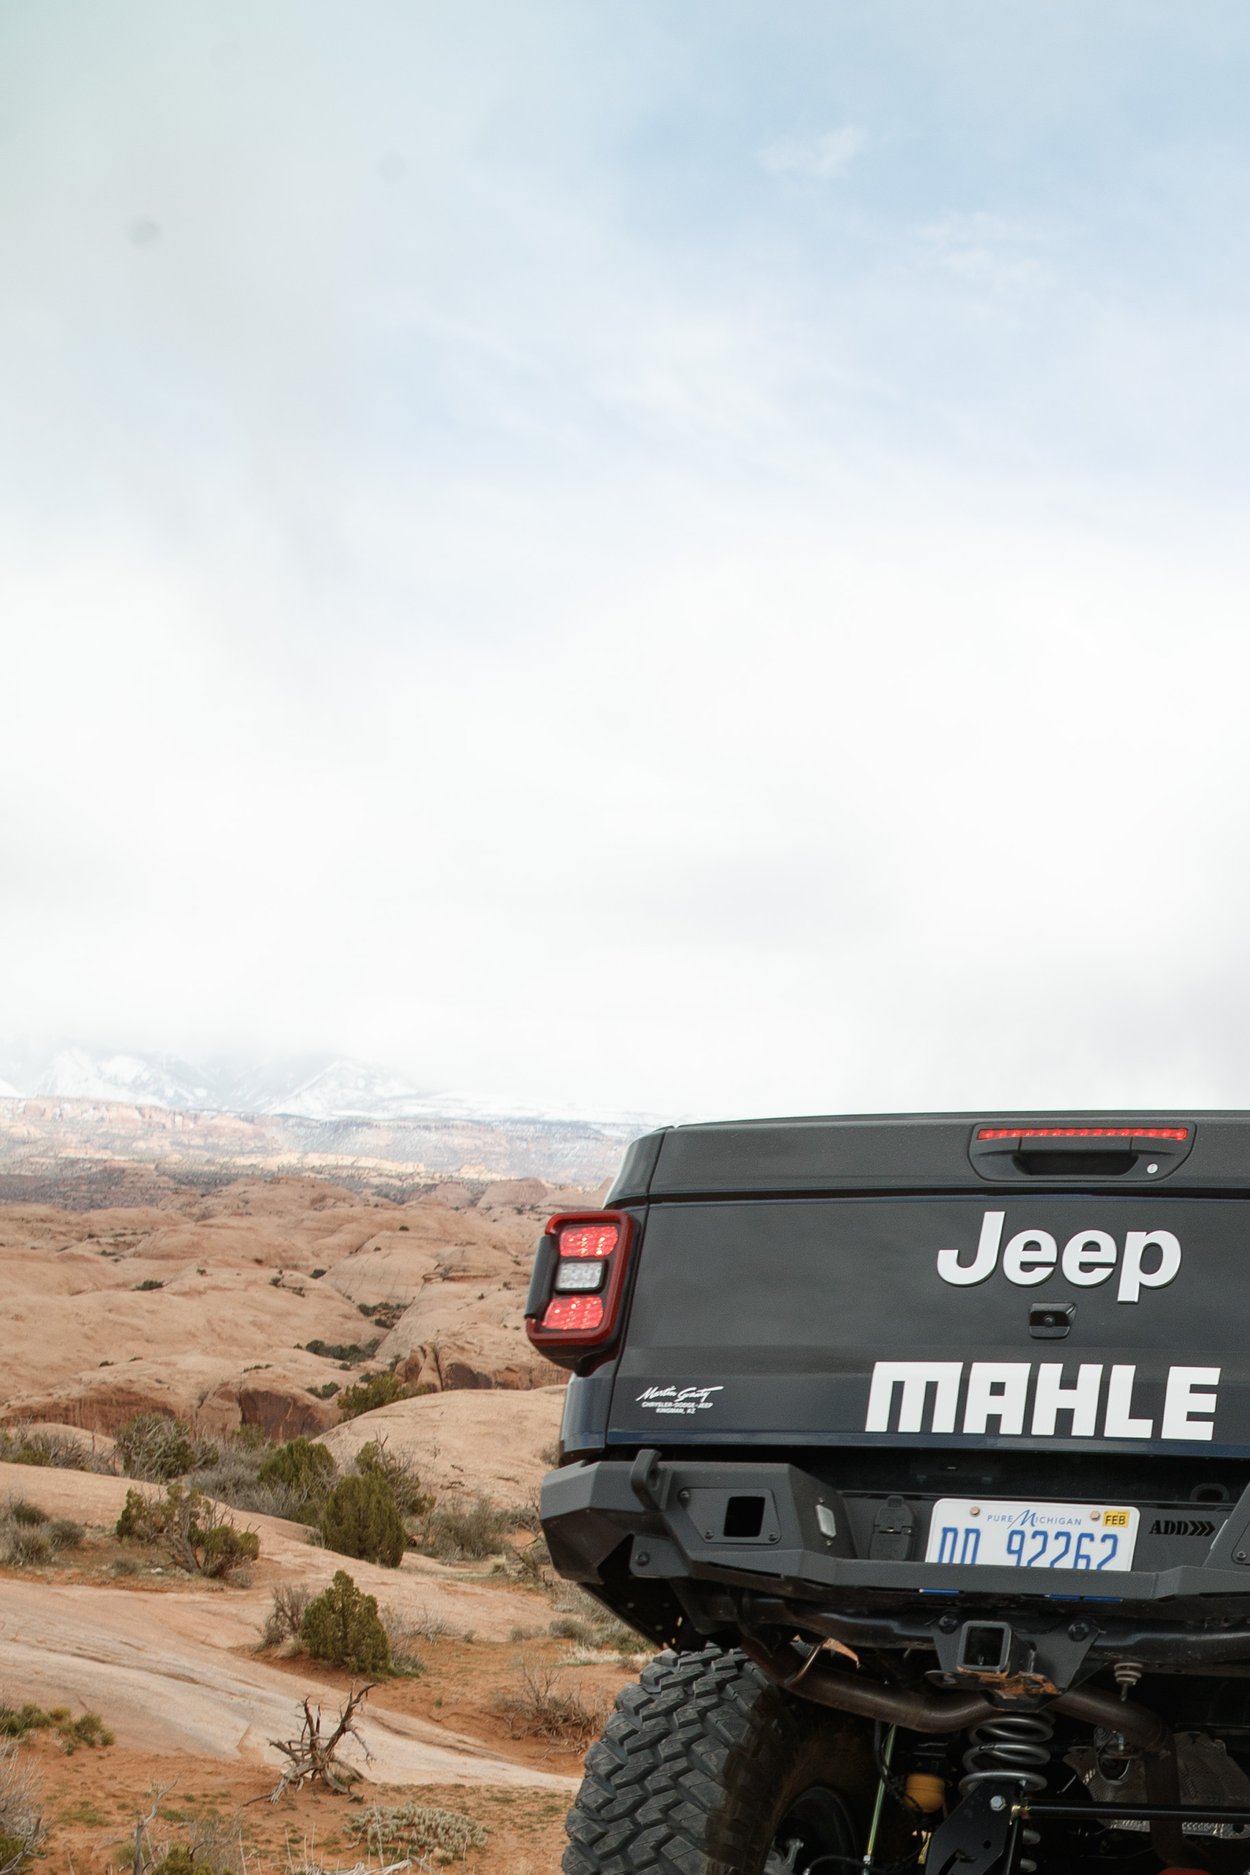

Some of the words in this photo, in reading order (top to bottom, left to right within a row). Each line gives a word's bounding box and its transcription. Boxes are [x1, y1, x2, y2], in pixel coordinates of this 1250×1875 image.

[937, 1211, 1182, 1304] Jeep
[865, 1361, 1222, 1441] MAHLE
[987, 1514, 1014, 1523] PURE
[1008, 1509, 1082, 1528] MICHIGAN
[1105, 1515, 1126, 1525] FEB
[1006, 1530, 1119, 1571] 92262
